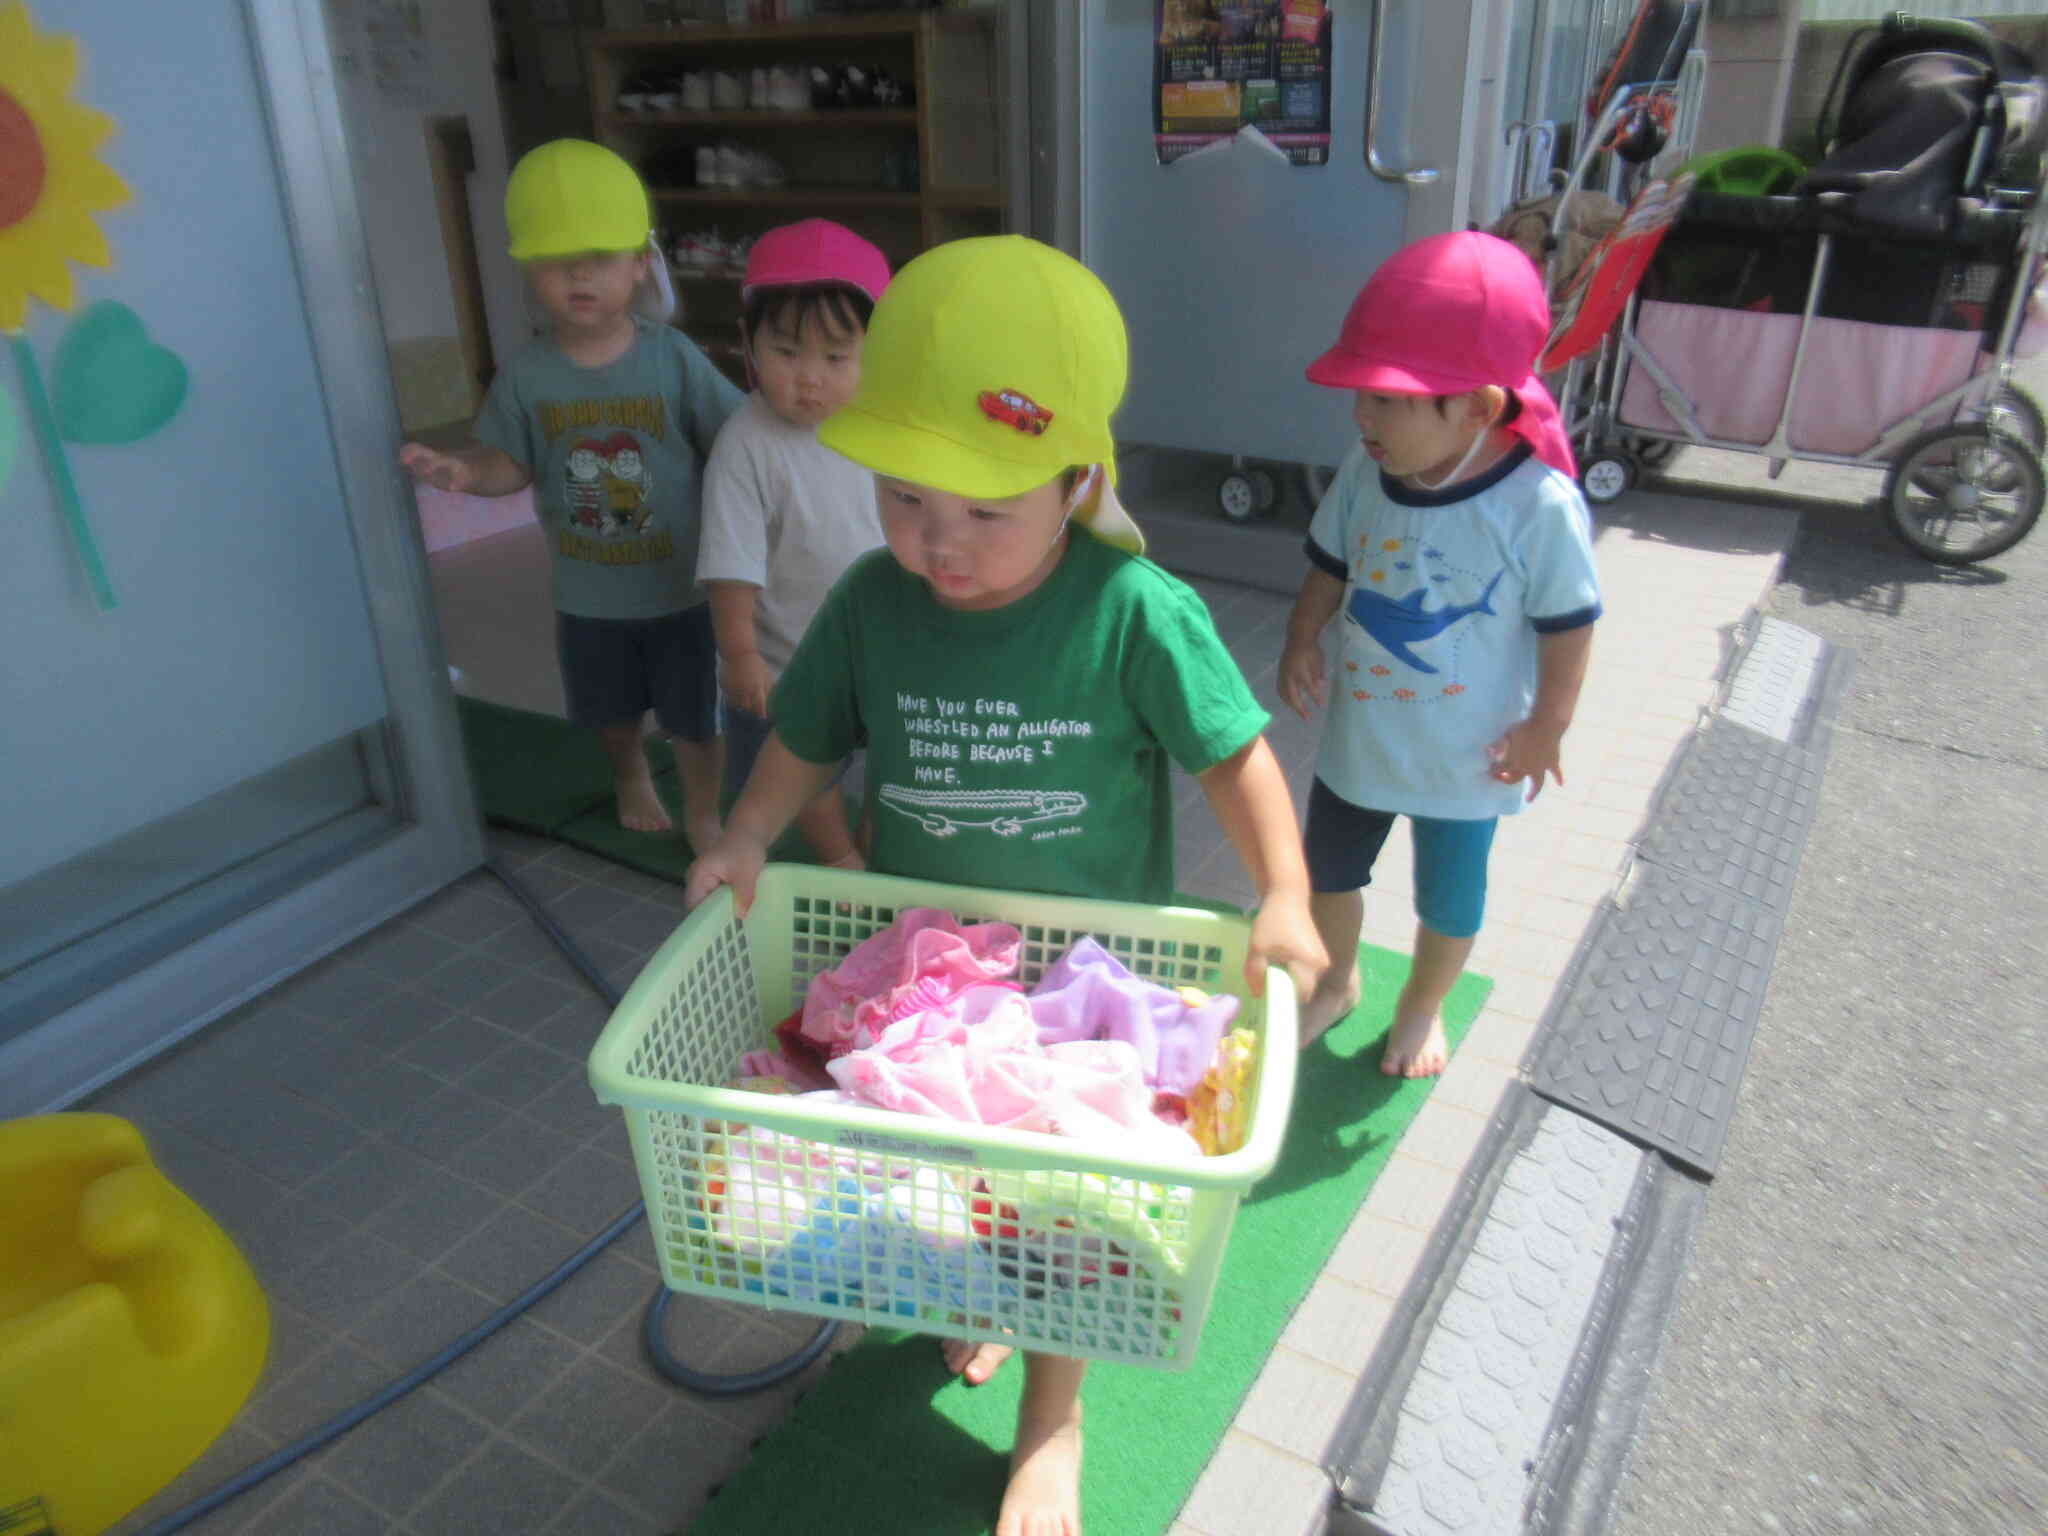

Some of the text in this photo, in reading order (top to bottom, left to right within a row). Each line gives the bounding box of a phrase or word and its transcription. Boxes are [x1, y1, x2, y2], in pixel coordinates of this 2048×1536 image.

[897, 691, 1018, 717] HAVE YOU EVER
[903, 717, 1092, 740] WRESTLED AN ALLIGATOR
[909, 738, 1054, 762] BEFORE BECAUSE I
